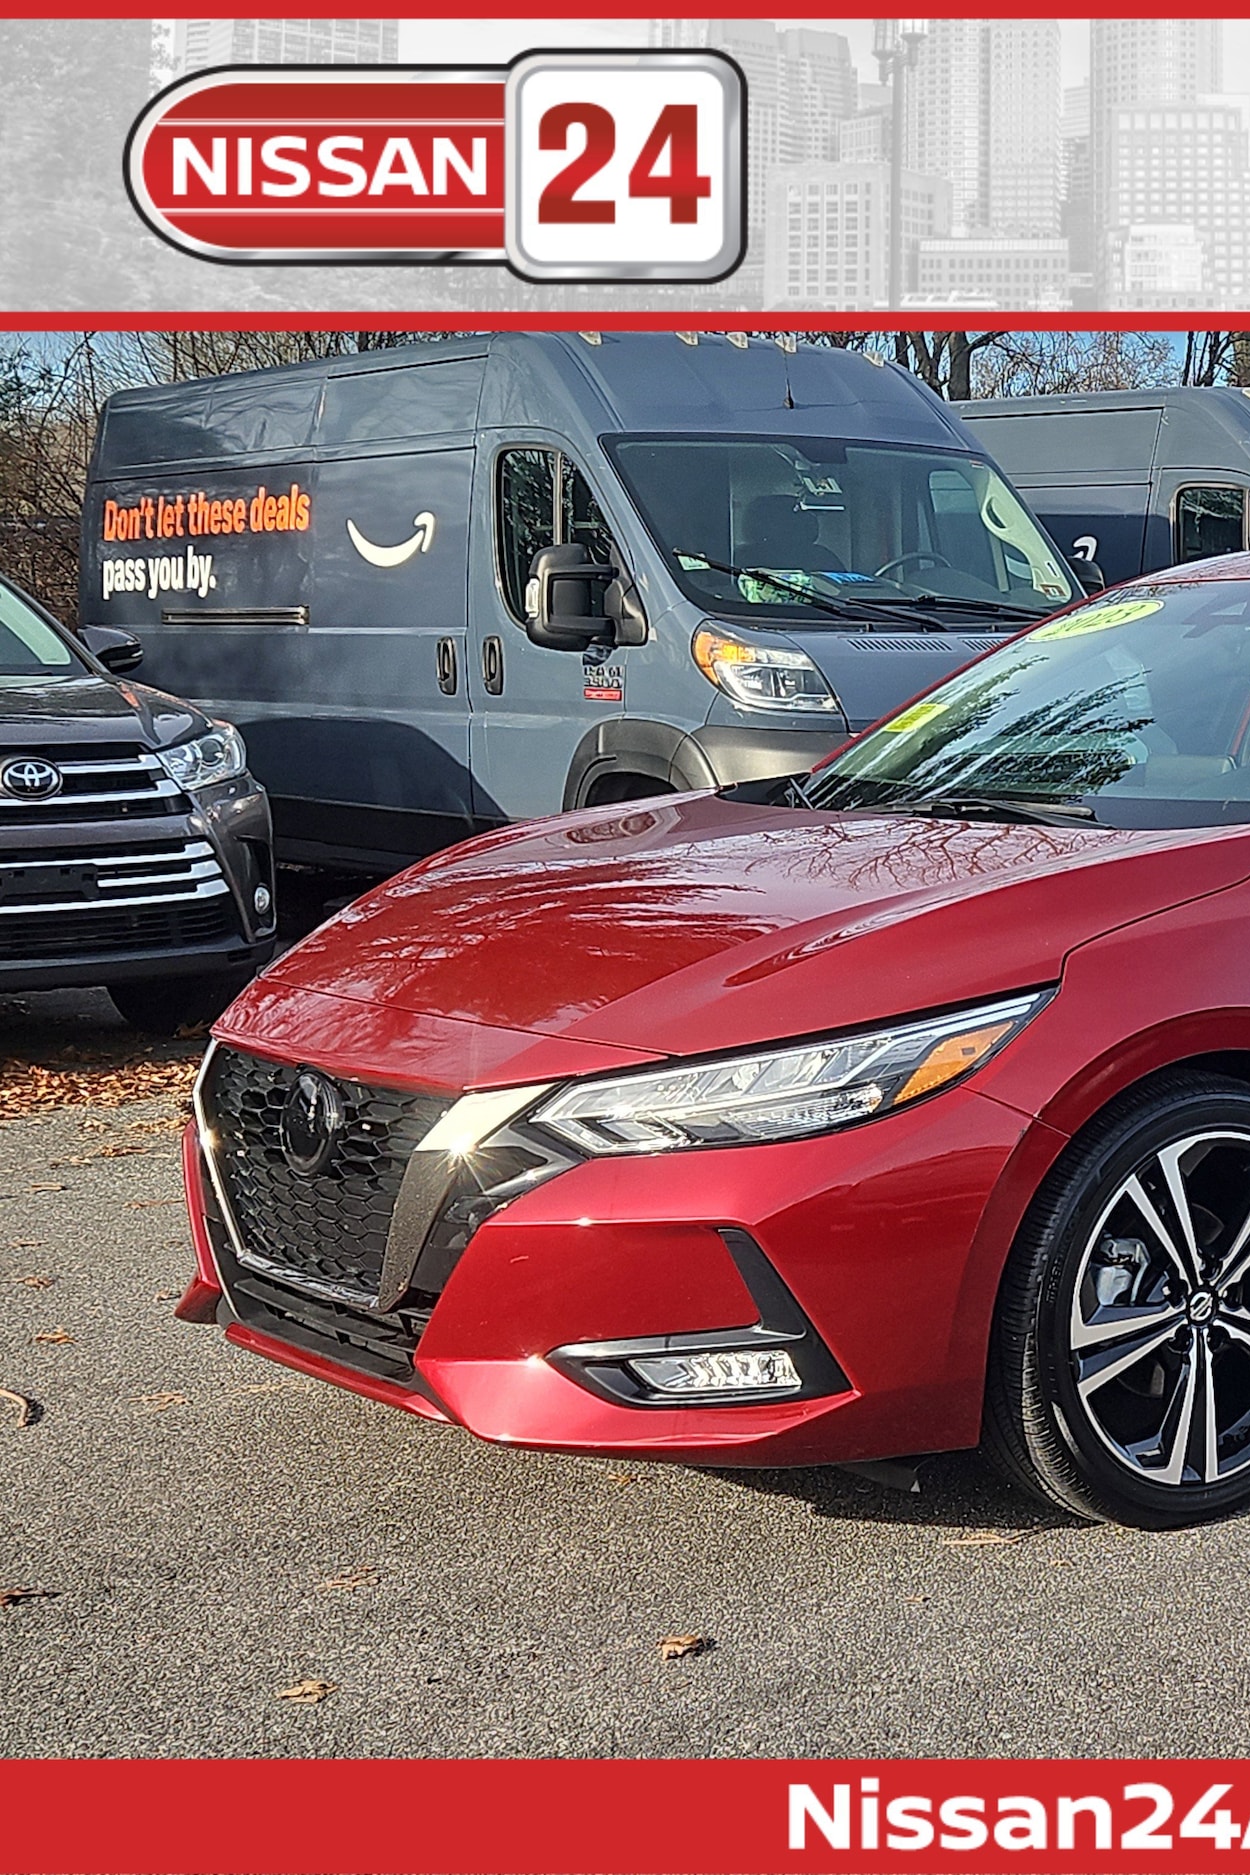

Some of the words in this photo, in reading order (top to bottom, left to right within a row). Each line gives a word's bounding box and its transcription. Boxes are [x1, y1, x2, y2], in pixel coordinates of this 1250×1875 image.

[103, 496, 154, 542] Don't
[156, 495, 185, 538] let
[187, 491, 246, 536] these
[250, 483, 312, 532] deals
[102, 558, 147, 600] pass
[148, 556, 184, 600] you
[186, 545, 217, 599] by.
